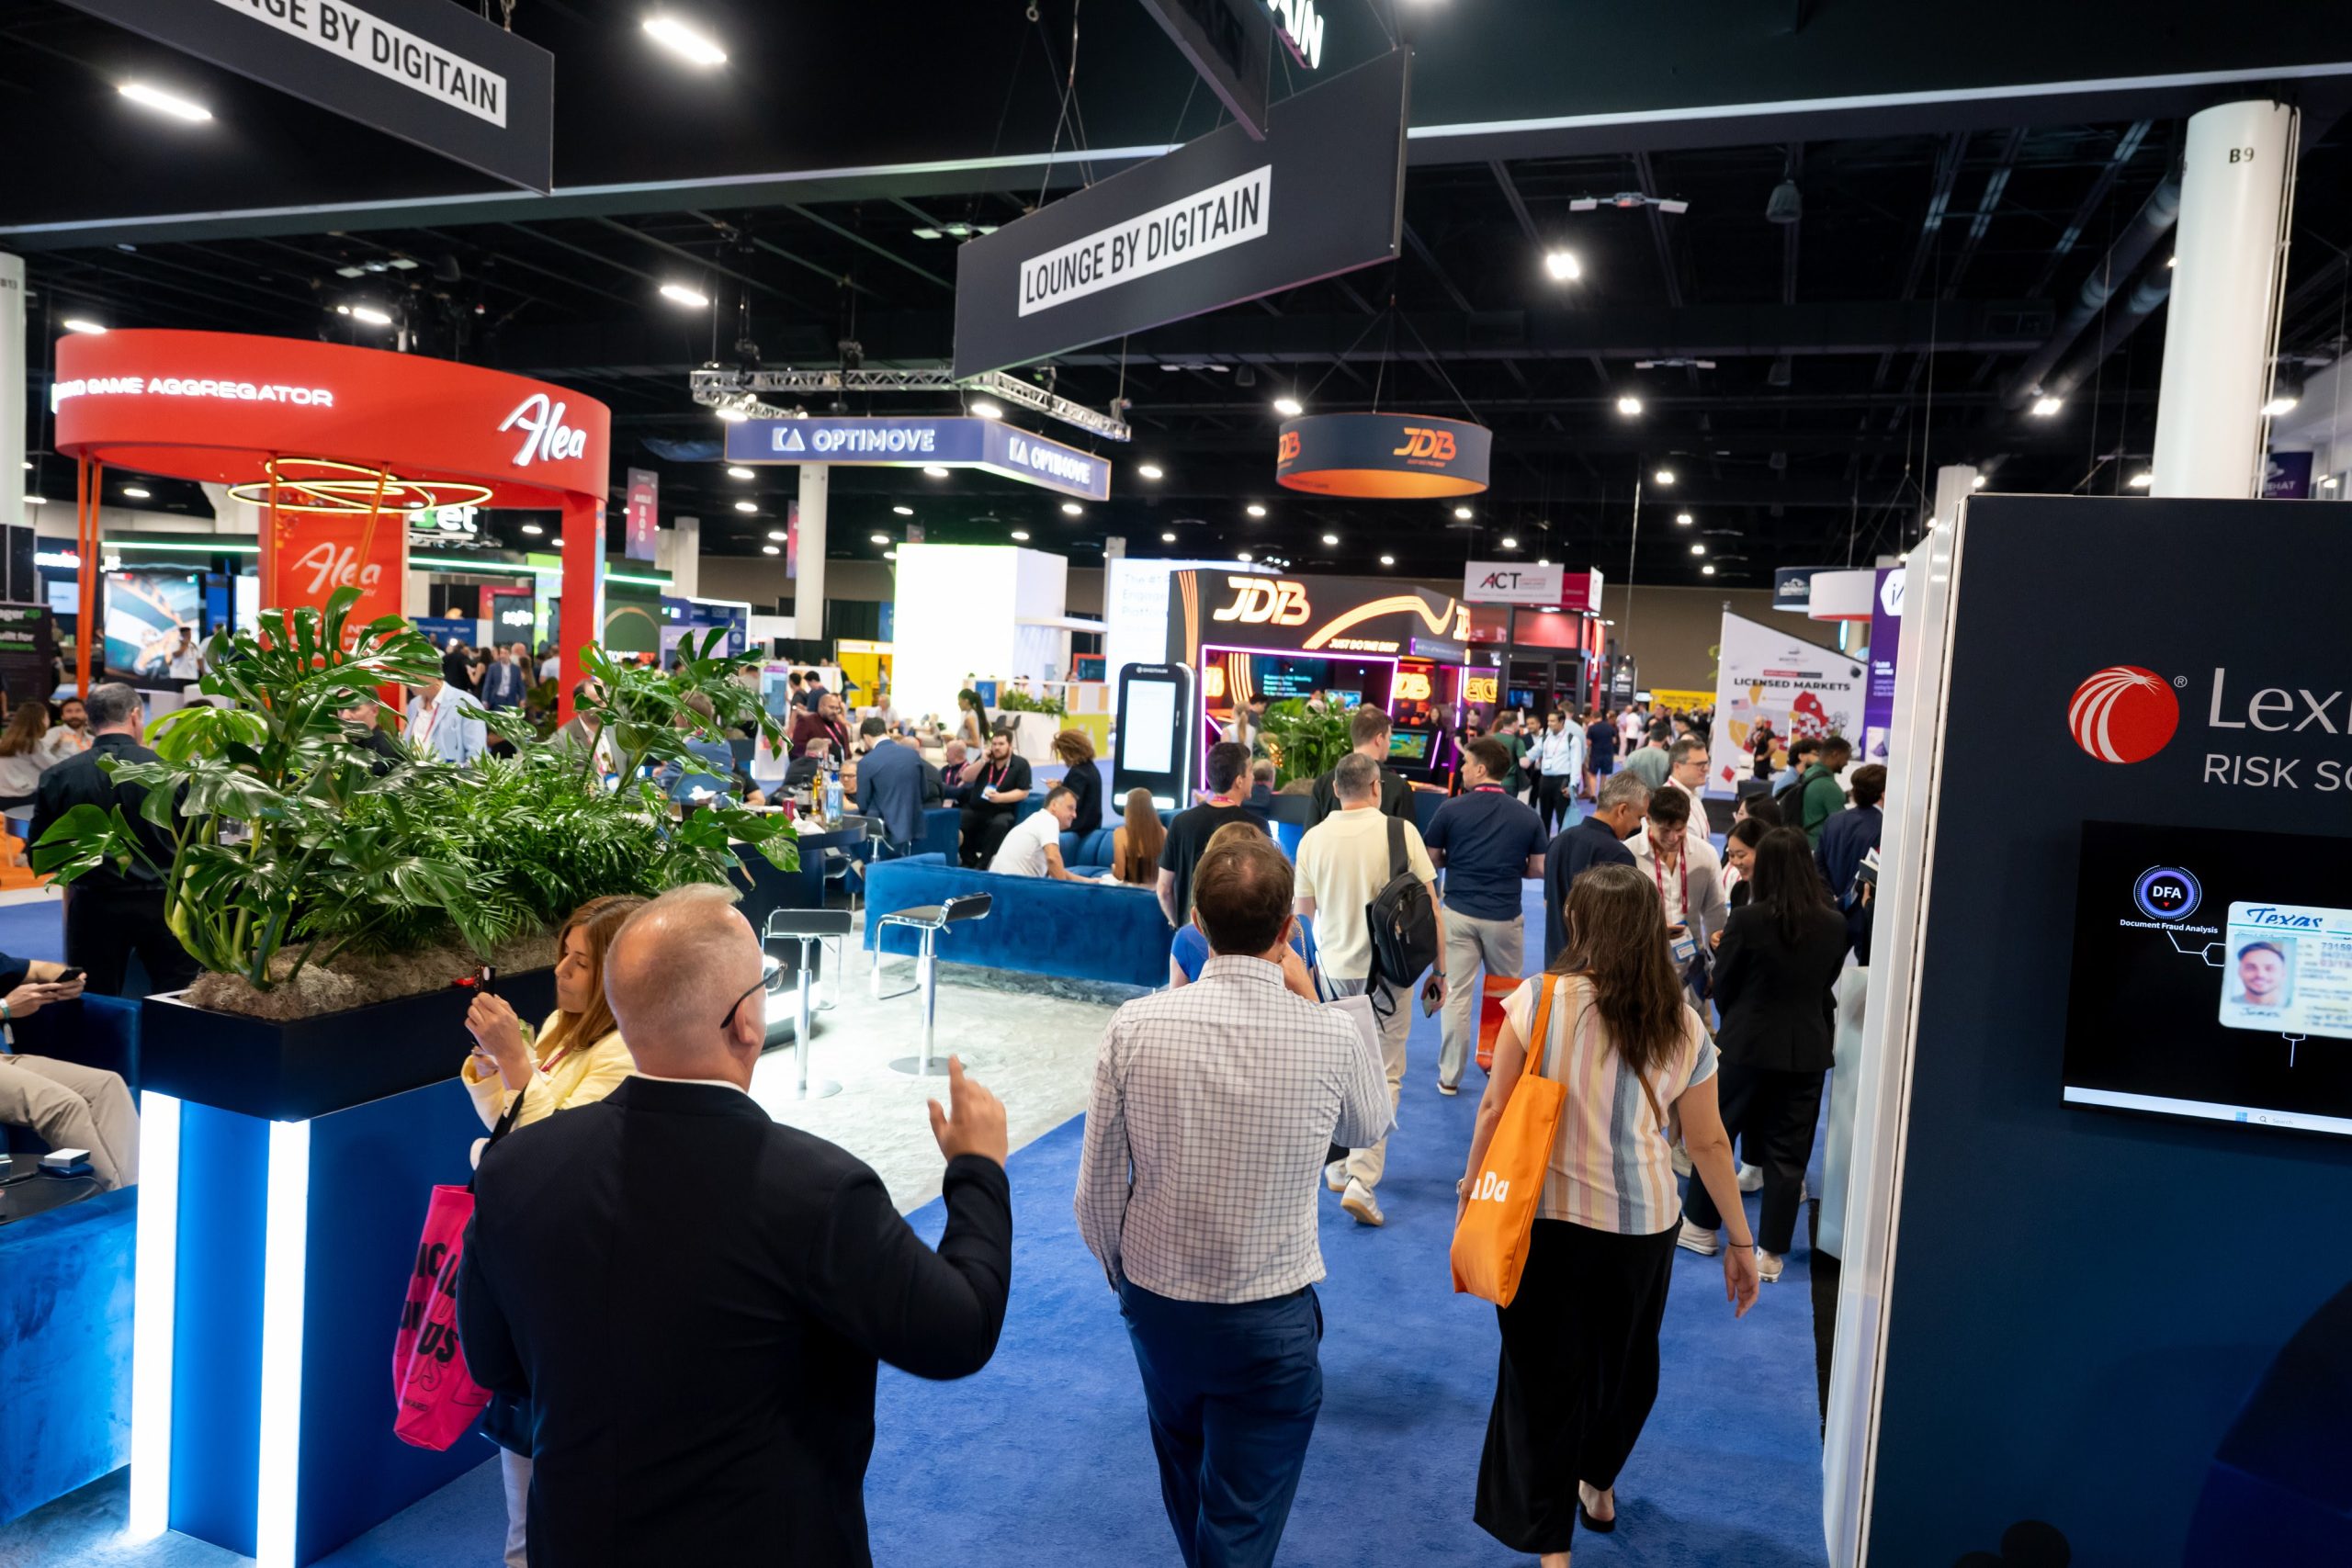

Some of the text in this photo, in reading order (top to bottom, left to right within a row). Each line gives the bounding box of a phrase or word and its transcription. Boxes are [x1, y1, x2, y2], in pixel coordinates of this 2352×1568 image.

[321, 3, 360, 51] BY
[372, 27, 497, 114] DIGITAIN
[2229, 147, 2255, 164] B9
[1026, 183, 1261, 304] LOUNGE BY DIGITAIN
[87, 377, 334, 407] GAME AGGREGATOR
[498, 393, 587, 467] Alea
[812, 429, 935, 452] OPTIMOVE
[1394, 427, 1456, 460] JDB
[1031, 449, 1091, 485] OPTIMOVE
[290, 542, 382, 594] Alea
[1480, 572, 1521, 590] ACT
[1213, 576, 1311, 626] JDB
[1329, 637, 1350, 649] JUST
[1734, 678, 1850, 691] LICENSED MARKETS
[2204, 753, 2352, 792] RISK S
[2153, 886, 2182, 899] DFA
[2120, 919, 2219, 934] Document Fraud Analysis
[2246, 908, 2324, 928] Texas
[2272, 1118, 2293, 1126] Search
